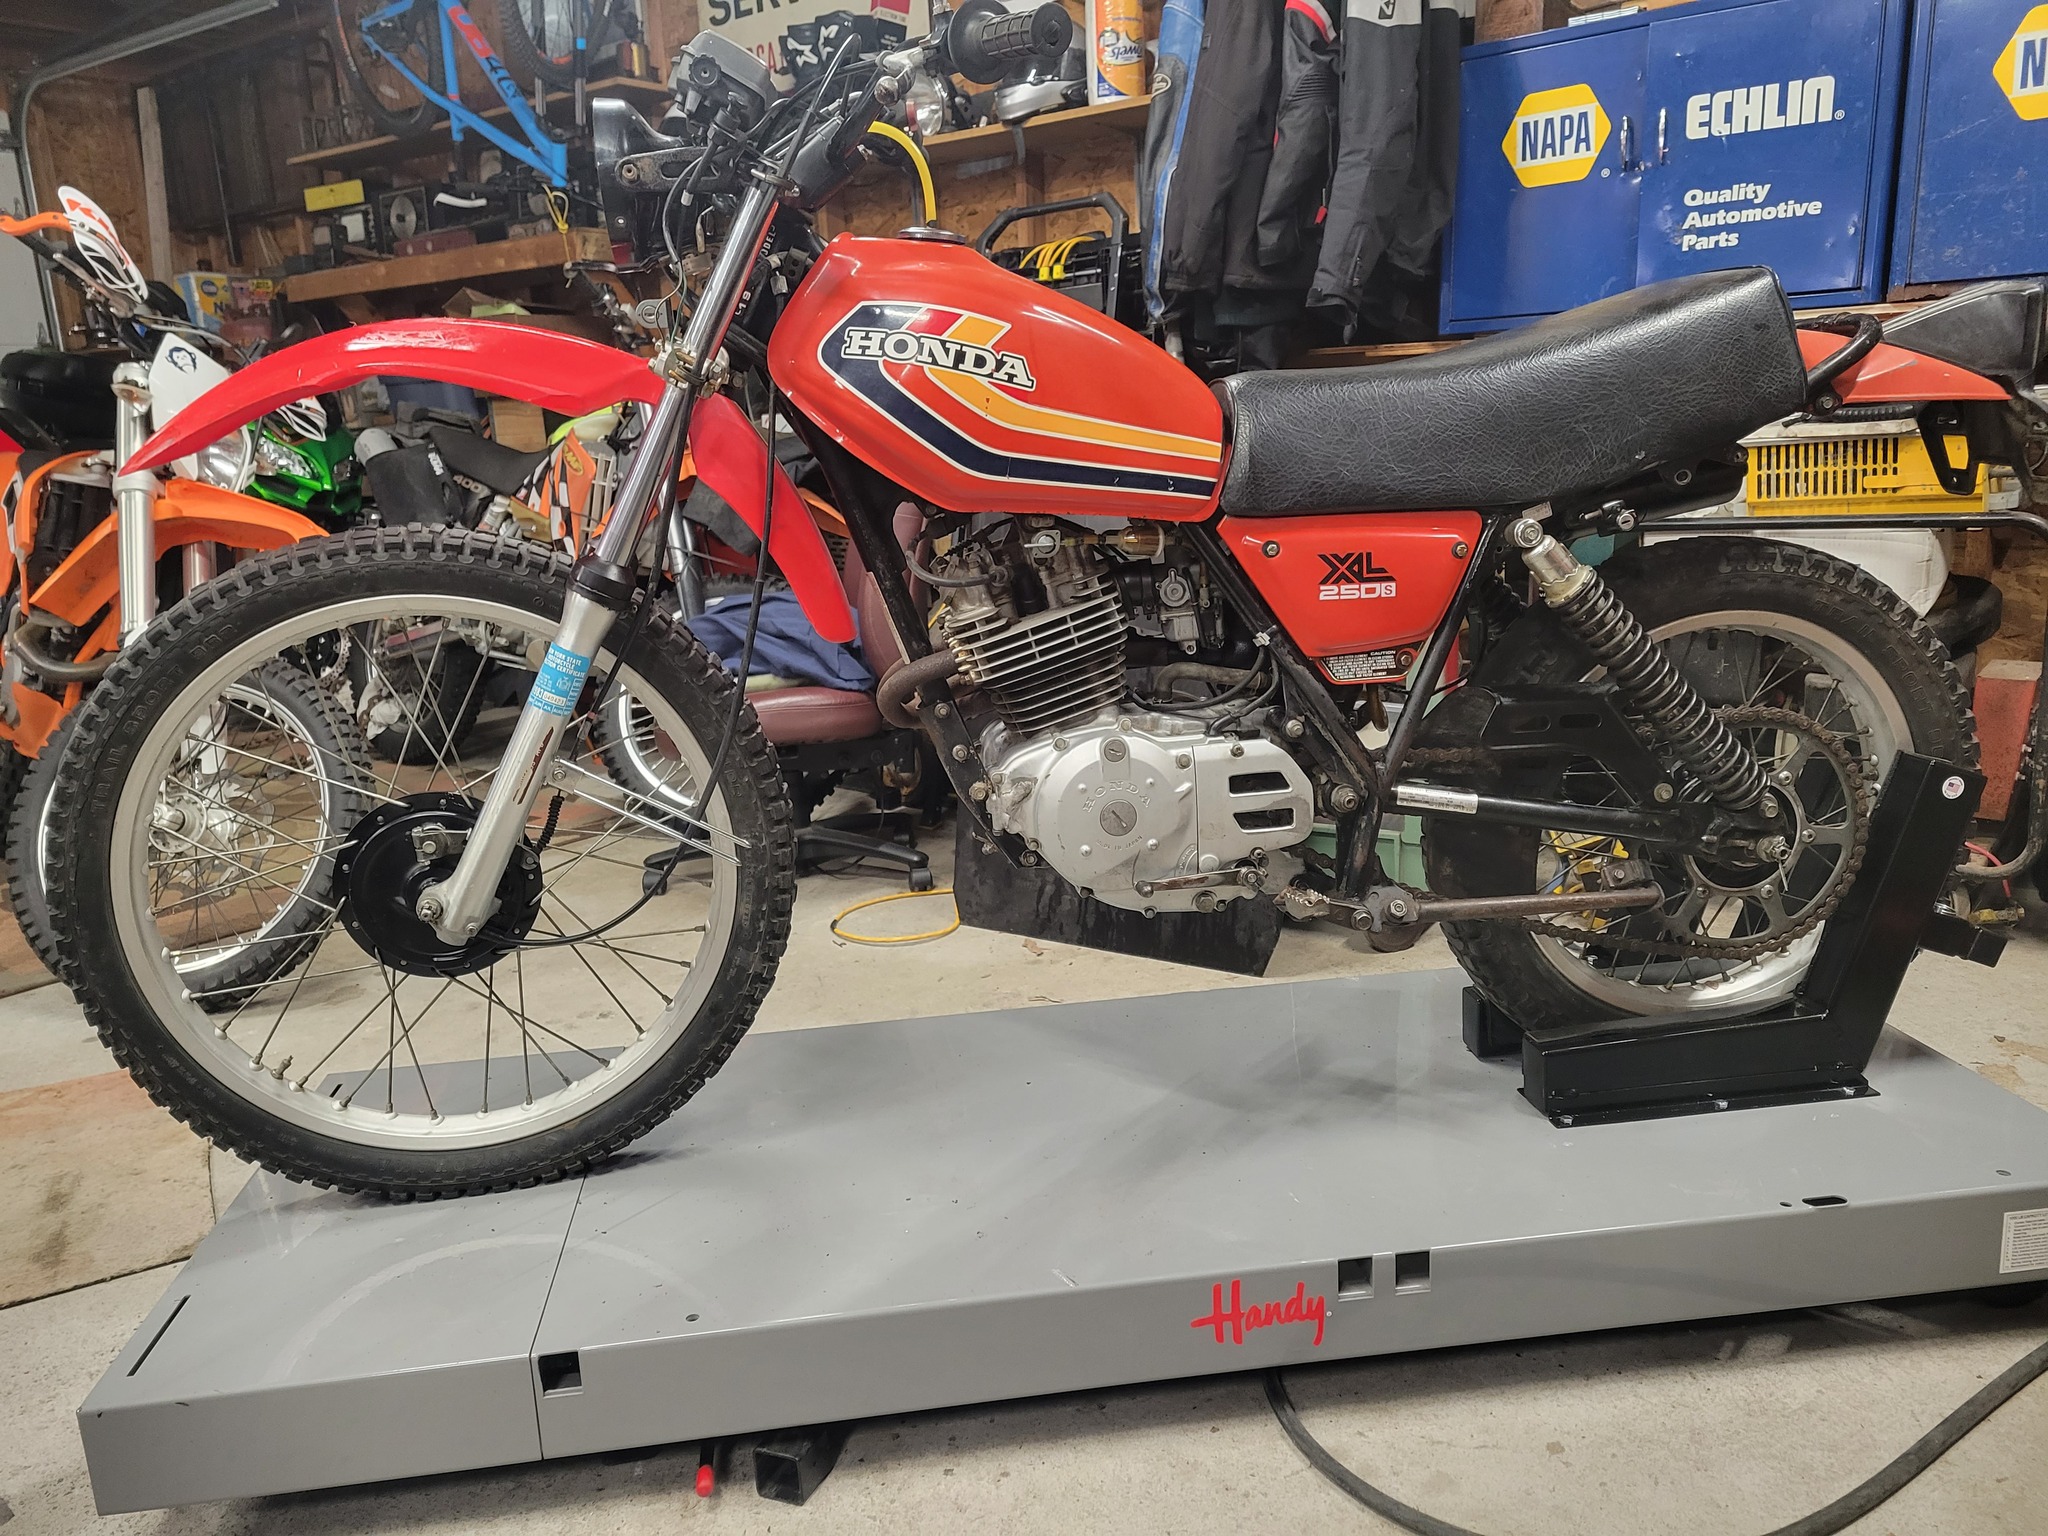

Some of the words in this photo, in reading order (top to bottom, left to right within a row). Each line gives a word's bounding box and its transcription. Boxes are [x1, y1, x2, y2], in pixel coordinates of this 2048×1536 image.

[1685, 75, 1836, 140] ECHLIN
[1521, 111, 1592, 162] NAPA
[1683, 182, 1772, 208] Quality
[1682, 200, 1823, 230] Automotive
[1681, 230, 1740, 252] Parts
[842, 327, 1036, 391] HONDA
[453, 474, 483, 496] 400
[1317, 551, 1397, 585] XL
[91, 743, 128, 819] TRAIL
[123, 664, 184, 735] SPORT
[1082, 780, 1152, 813] HONDA
[1190, 1279, 1326, 1346] Handy
